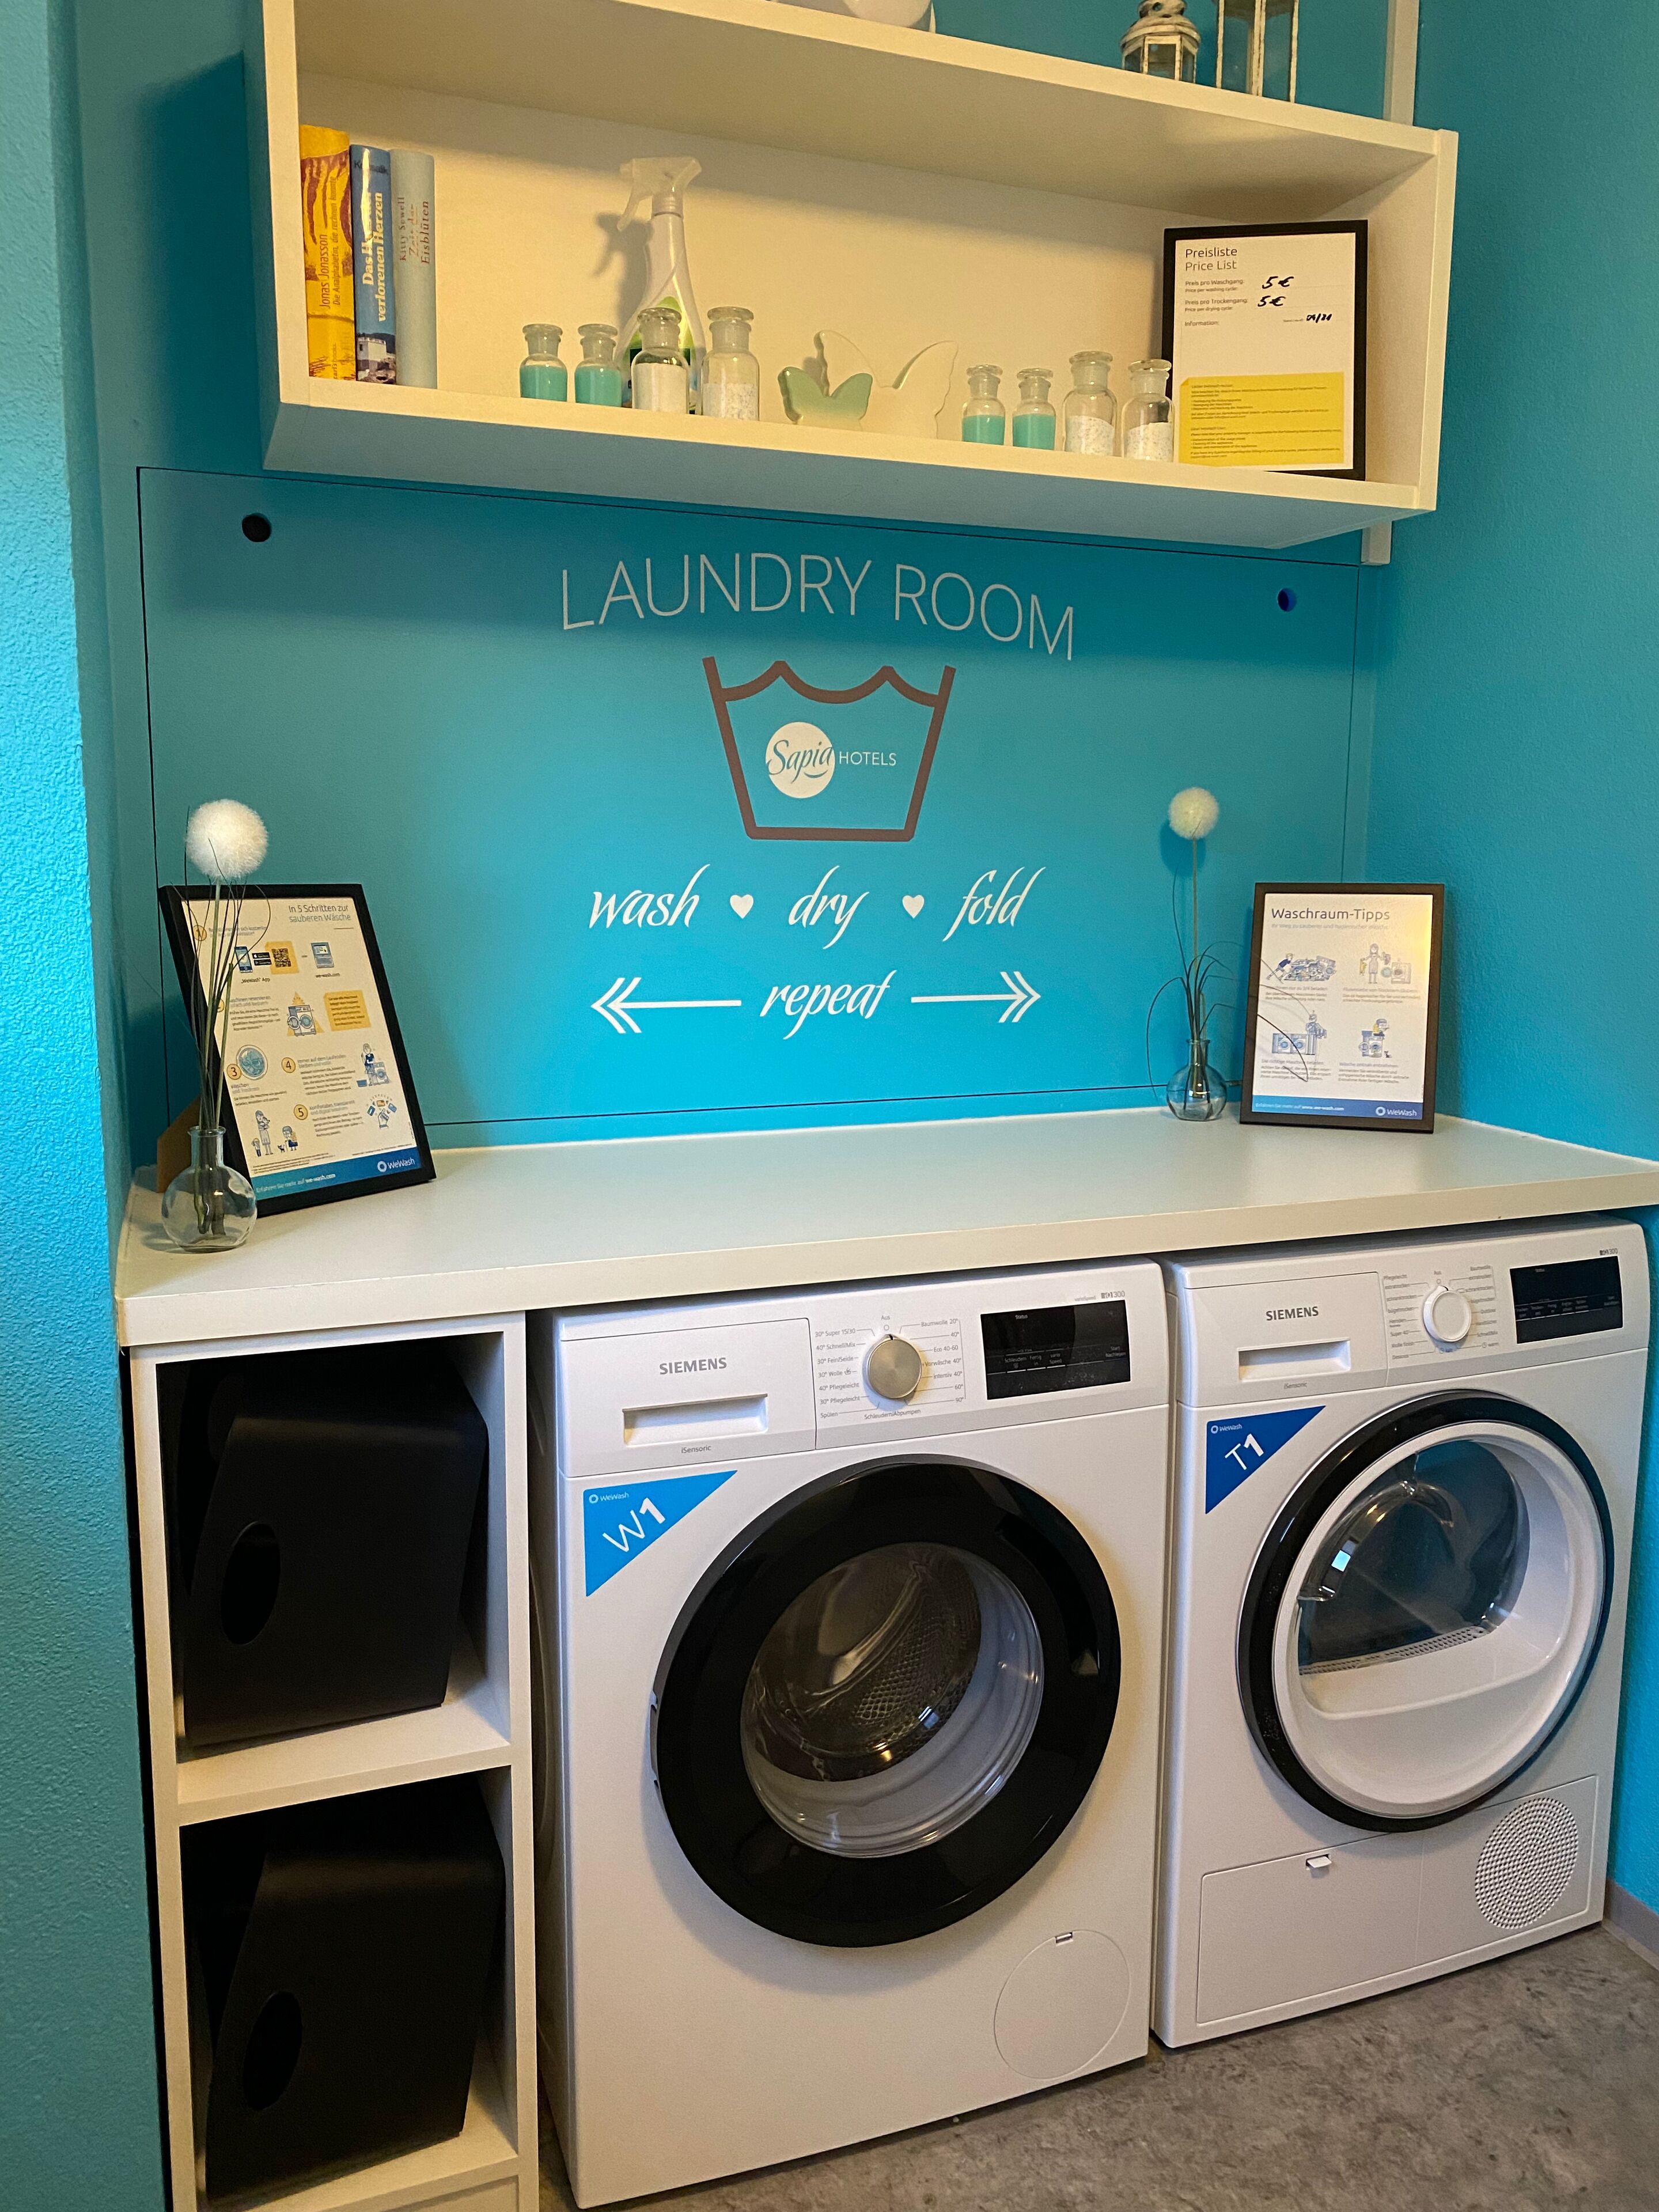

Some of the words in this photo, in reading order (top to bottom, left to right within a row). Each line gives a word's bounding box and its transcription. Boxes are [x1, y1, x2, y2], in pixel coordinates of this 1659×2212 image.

[373, 192, 384, 244] Herzen
[319, 234, 329, 279] Jonasson
[1185, 247, 1237, 258] Preisliste
[362, 257, 374, 285] Das
[1185, 262, 1213, 271] Price
[1217, 260, 1237, 270] List
[375, 247, 387, 322] verlorenen
[319, 282, 330, 309] Jonas
[332, 294, 341, 305] Die
[561, 552, 872, 631] LAUNDRY
[894, 563, 1074, 661] ROOM
[766, 738, 836, 783] Sapia
[839, 751, 897, 767] HOTELS
[304, 904, 337, 912] Schritten
[589, 863, 711, 929] wash
[788, 865, 870, 950] dry
[942, 866, 1046, 942] fold
[289, 914, 323, 922] sauberen
[324, 913, 351, 922] Wäsche
[1271, 908, 1390, 922] Waschraum-Tipps
[760, 969, 897, 1040] repeat
[286, 1060, 292, 1070] 4
[230, 1067, 237, 1077] 3
[298, 1107, 304, 1117] 5
[388, 1157, 415, 1169] WeWash
[1266, 1306, 1319, 1321] SIEMENS
[827, 1355, 854, 1363] Fein/Seide
[660, 1357, 727, 1375] SIEMENS
[830, 1382, 859, 1391] Pflegeleicht
[830, 1395, 861, 1404] Pflegeleicht
[864, 1408, 921, 1419] Schleudern/Abpumpen
[1219, 1424, 1243, 1433] WeWash
[681, 1445, 712, 1454] iSensoric
[1225, 1433, 1264, 1470] T1
[600, 1492, 629, 1502] WeWash
[603, 1497, 666, 1552] W1
